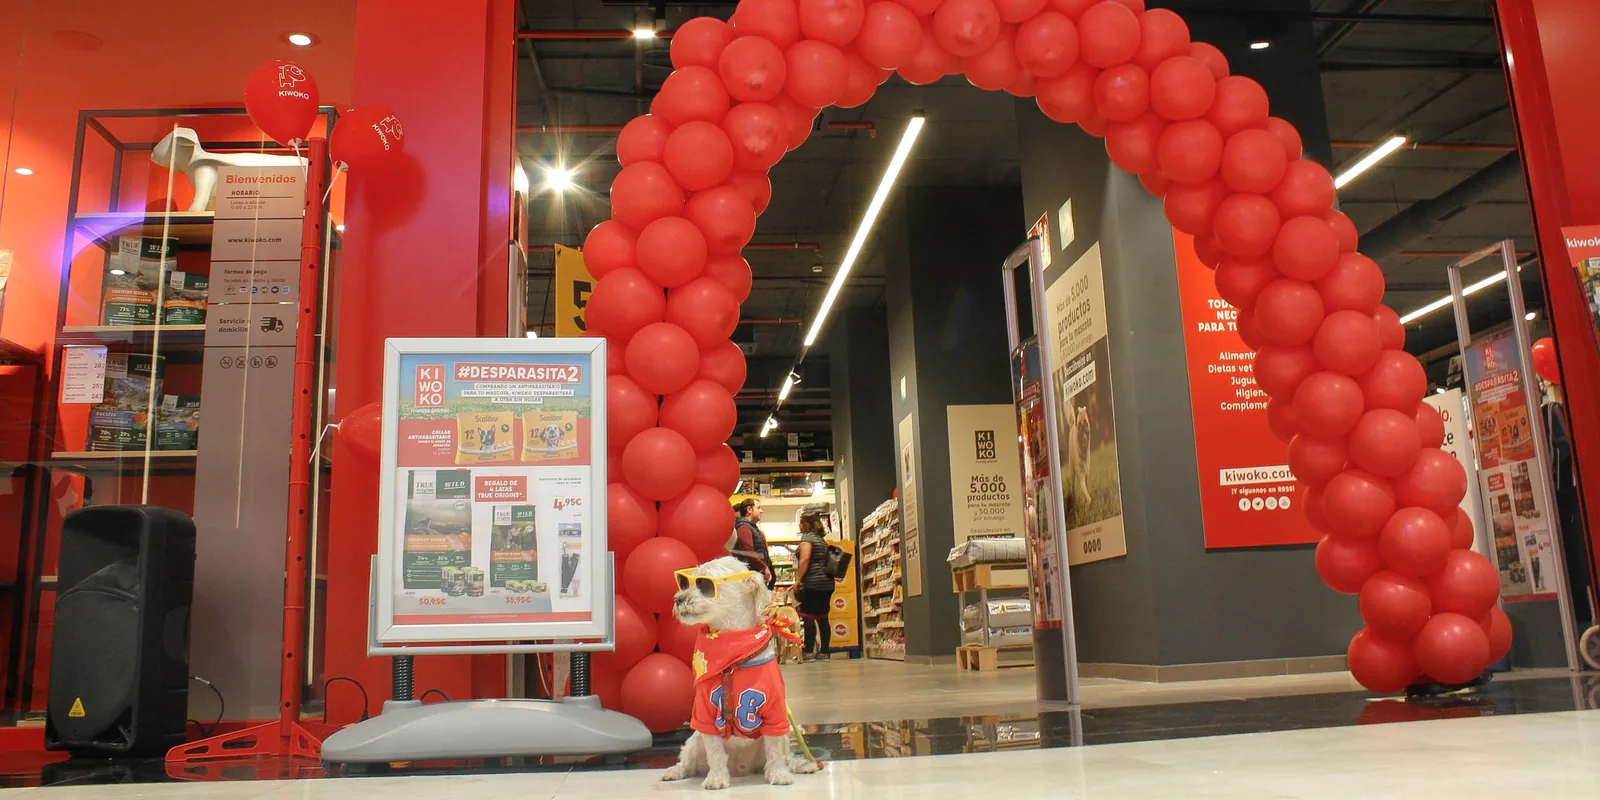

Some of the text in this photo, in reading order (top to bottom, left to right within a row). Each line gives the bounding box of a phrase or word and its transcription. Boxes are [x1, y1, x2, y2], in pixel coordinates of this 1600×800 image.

[278, 90, 309, 100] KIWOKO
[372, 123, 390, 151] KIWOKO
[226, 174, 296, 184] Bienvenidos
[1071, 274, 1089, 301] 5.000
[1207, 299, 1234, 309] TOD
[1057, 298, 1091, 341] productos
[1216, 310, 1237, 320] NEC
[1198, 322, 1225, 332] PARA
[1219, 351, 1256, 360] Aliment
[458, 365, 579, 382] #DESPARASITA2
[1208, 364, 1253, 373] Dietas vet
[1064, 368, 1094, 398] kiwoko.com
[1235, 389, 1268, 399] Higien
[1220, 401, 1268, 412] Compleme
[464, 430, 474, 440] 12
[529, 428, 539, 438] 12
[971, 474, 1004, 483] Más de
[970, 482, 1006, 493] 5.000
[1239, 486, 1267, 496] síguenos
[967, 493, 1010, 503] productos
[553, 498, 582, 511] 4,95€
[419, 598, 447, 606] 50,95€
